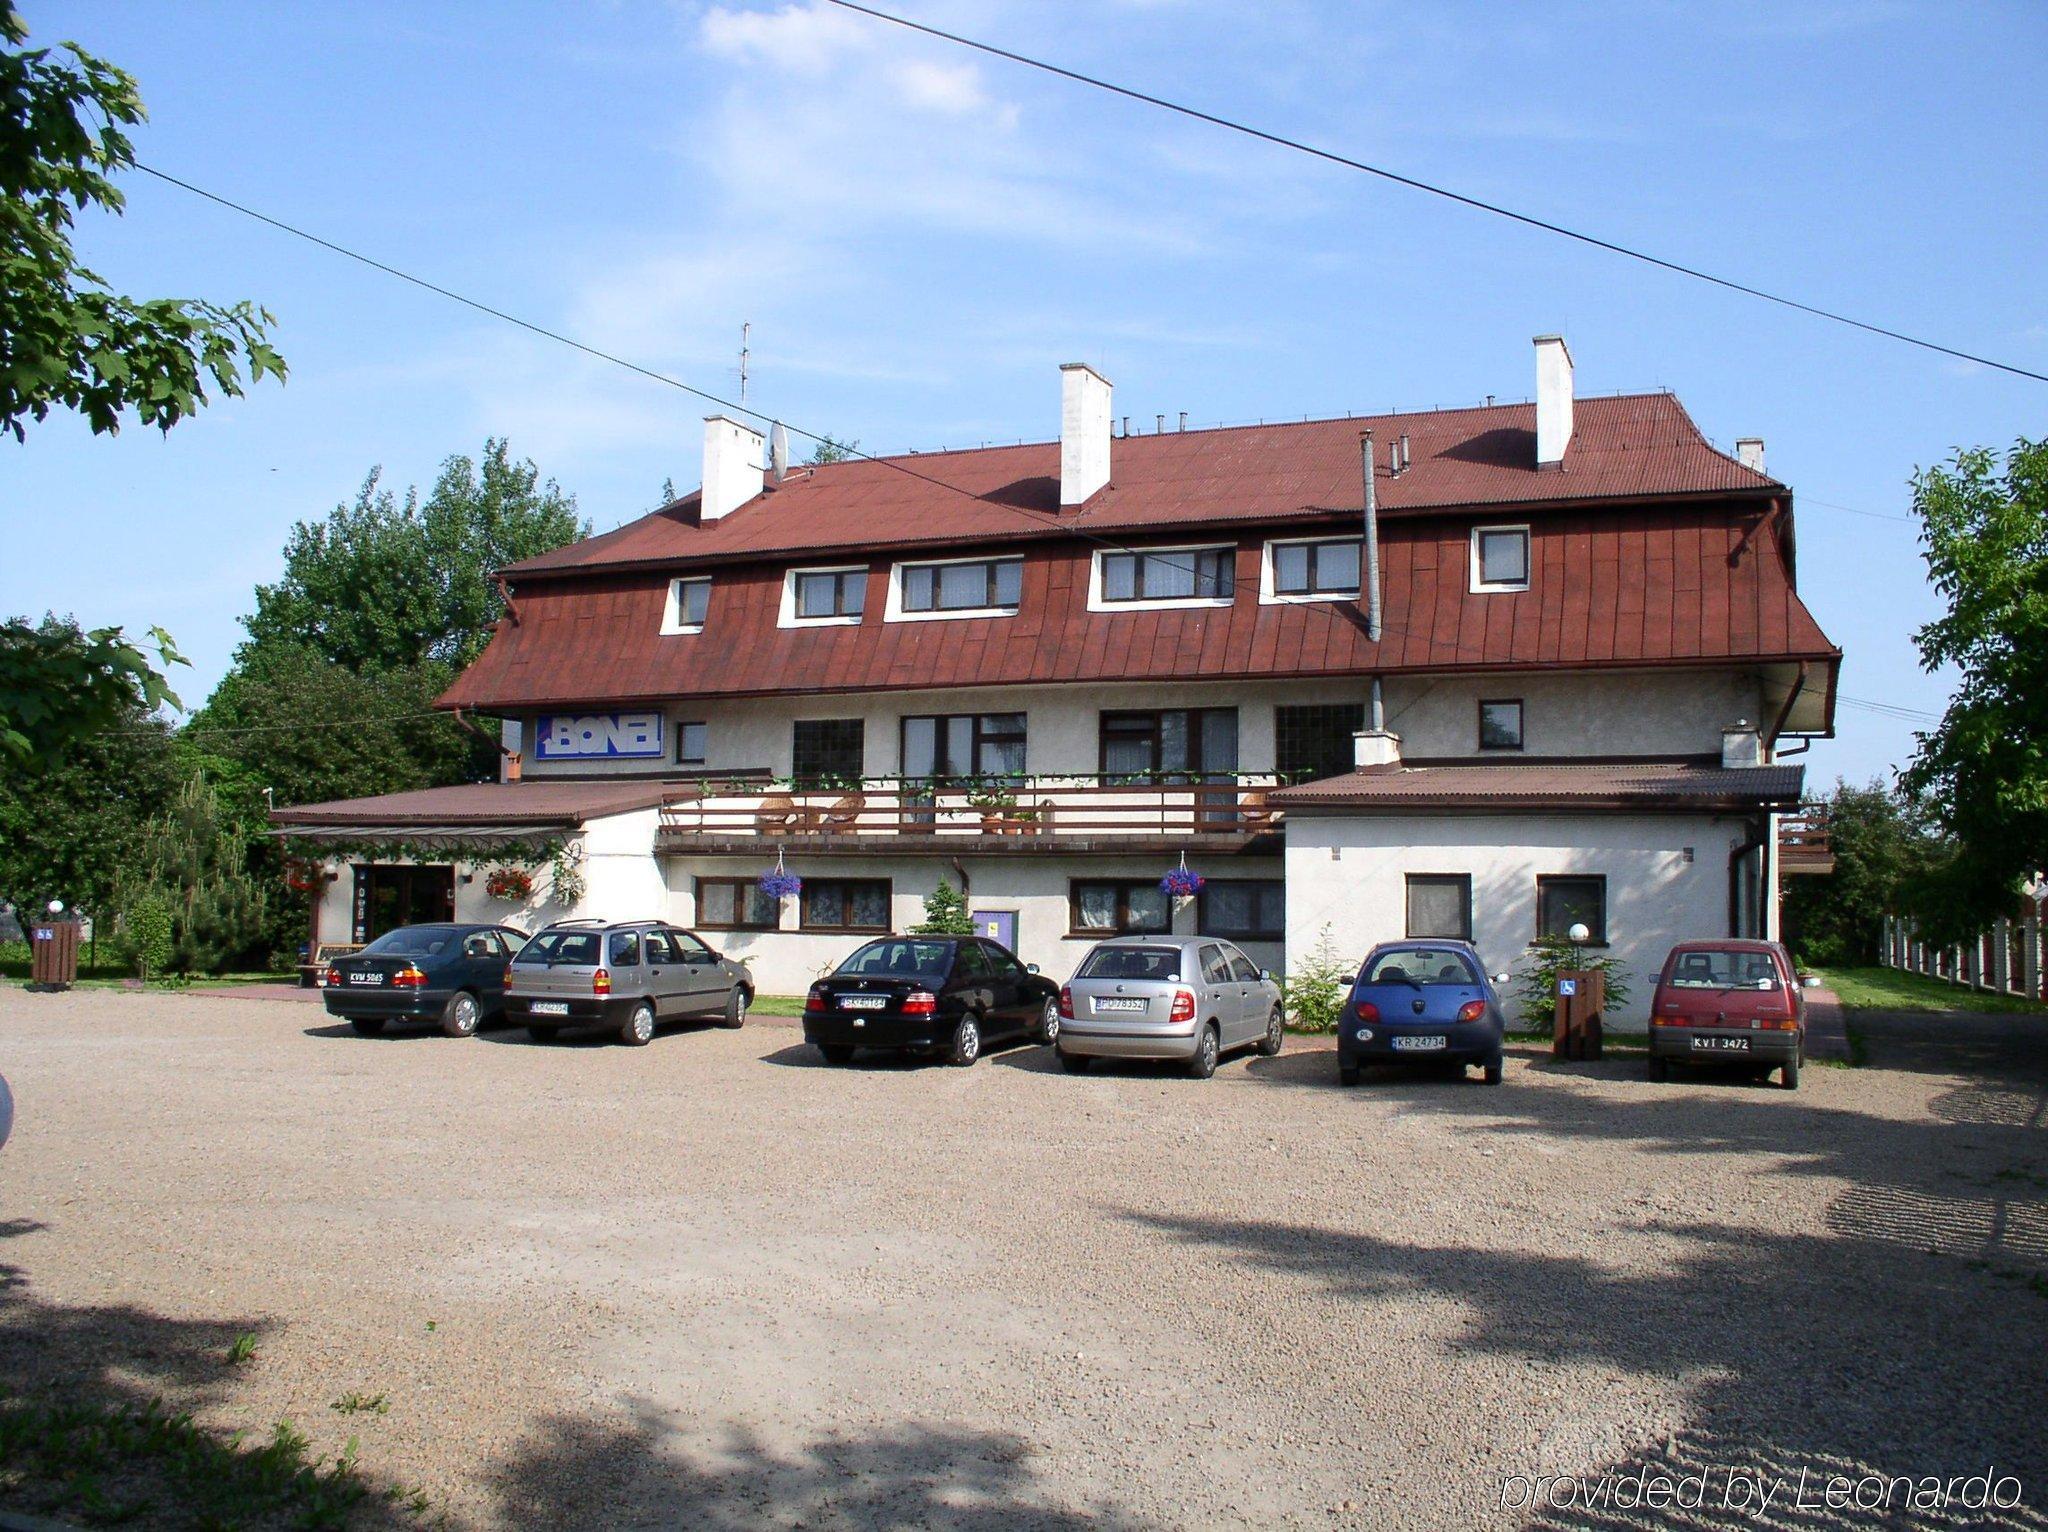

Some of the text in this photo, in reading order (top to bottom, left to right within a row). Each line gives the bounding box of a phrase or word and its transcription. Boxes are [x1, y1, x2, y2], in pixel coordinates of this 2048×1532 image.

[1398, 1037, 1444, 1047] KR 24734
[1694, 1038, 1749, 1049] KVT 3472
